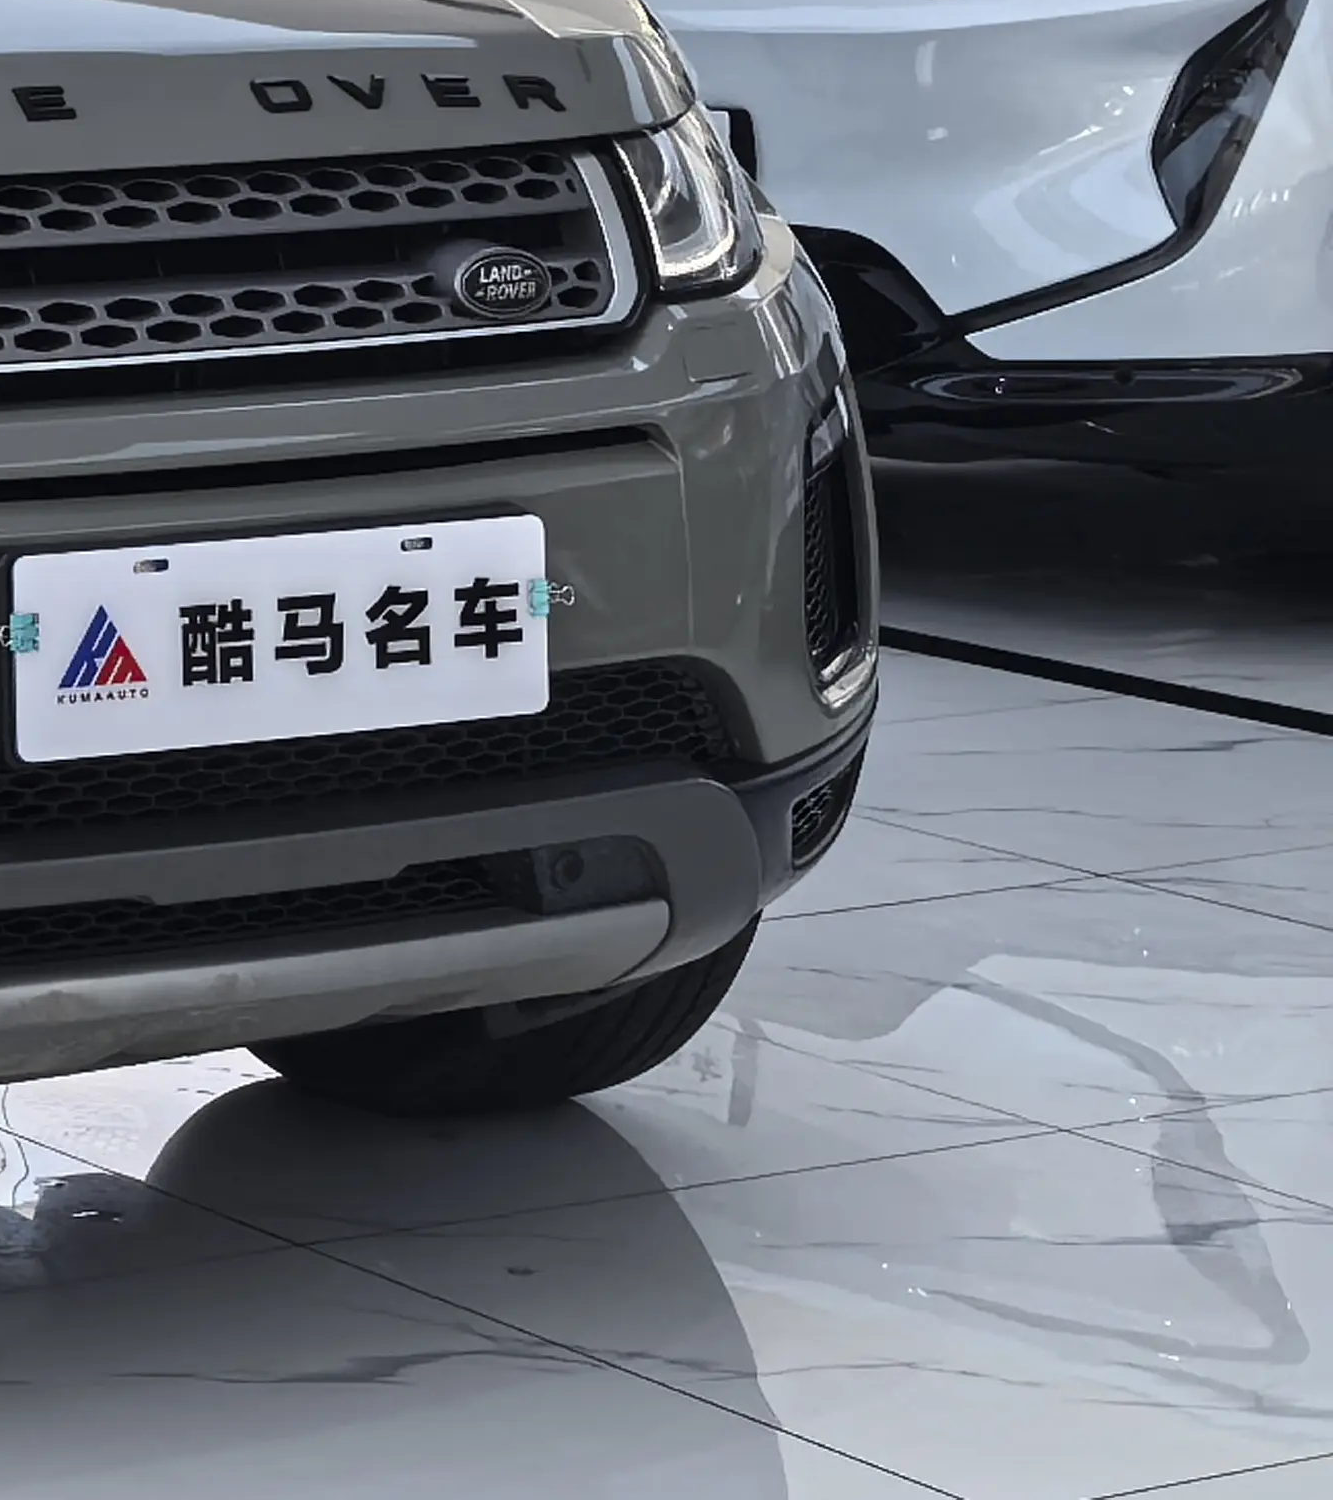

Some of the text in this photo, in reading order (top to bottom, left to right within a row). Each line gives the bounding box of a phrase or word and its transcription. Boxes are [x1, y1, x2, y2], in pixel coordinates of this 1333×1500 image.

[249, 72, 567, 114] OVER
[479, 265, 523, 284] LAND
[486, 281, 537, 301] ROVER
[179, 577, 523, 687] 酷马名车
[57, 688, 149, 704] KUMAAUTO
